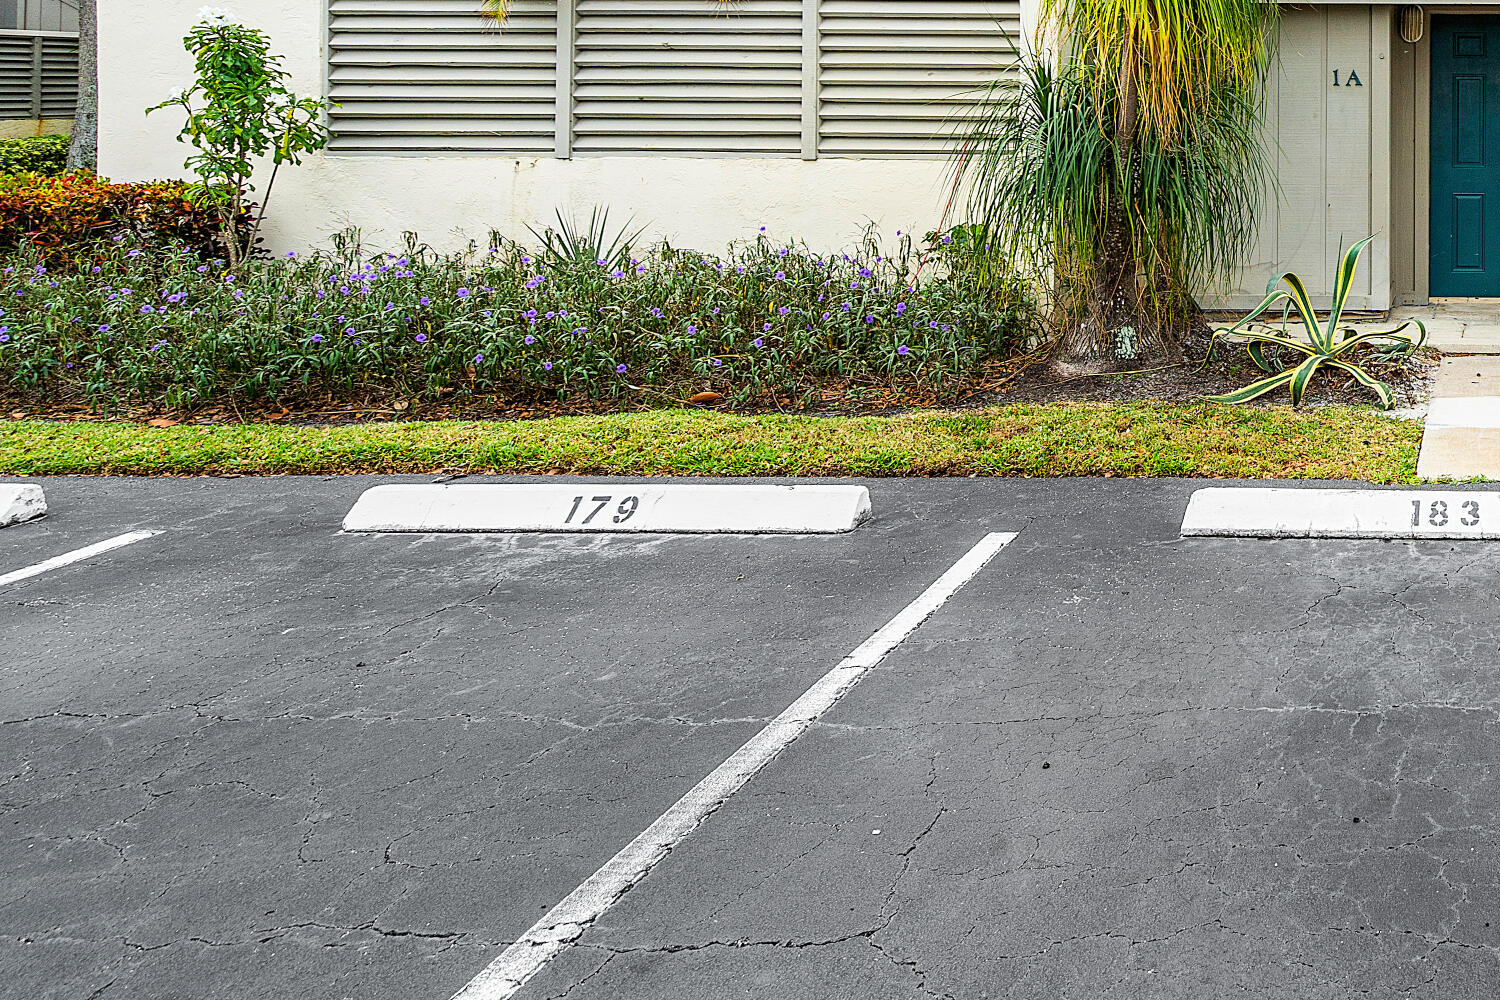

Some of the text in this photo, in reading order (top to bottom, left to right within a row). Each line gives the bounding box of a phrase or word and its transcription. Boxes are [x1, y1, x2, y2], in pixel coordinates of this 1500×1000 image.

[1332, 69, 1363, 87] 1A
[564, 495, 639, 525] 179
[1411, 500, 1480, 527] 183
